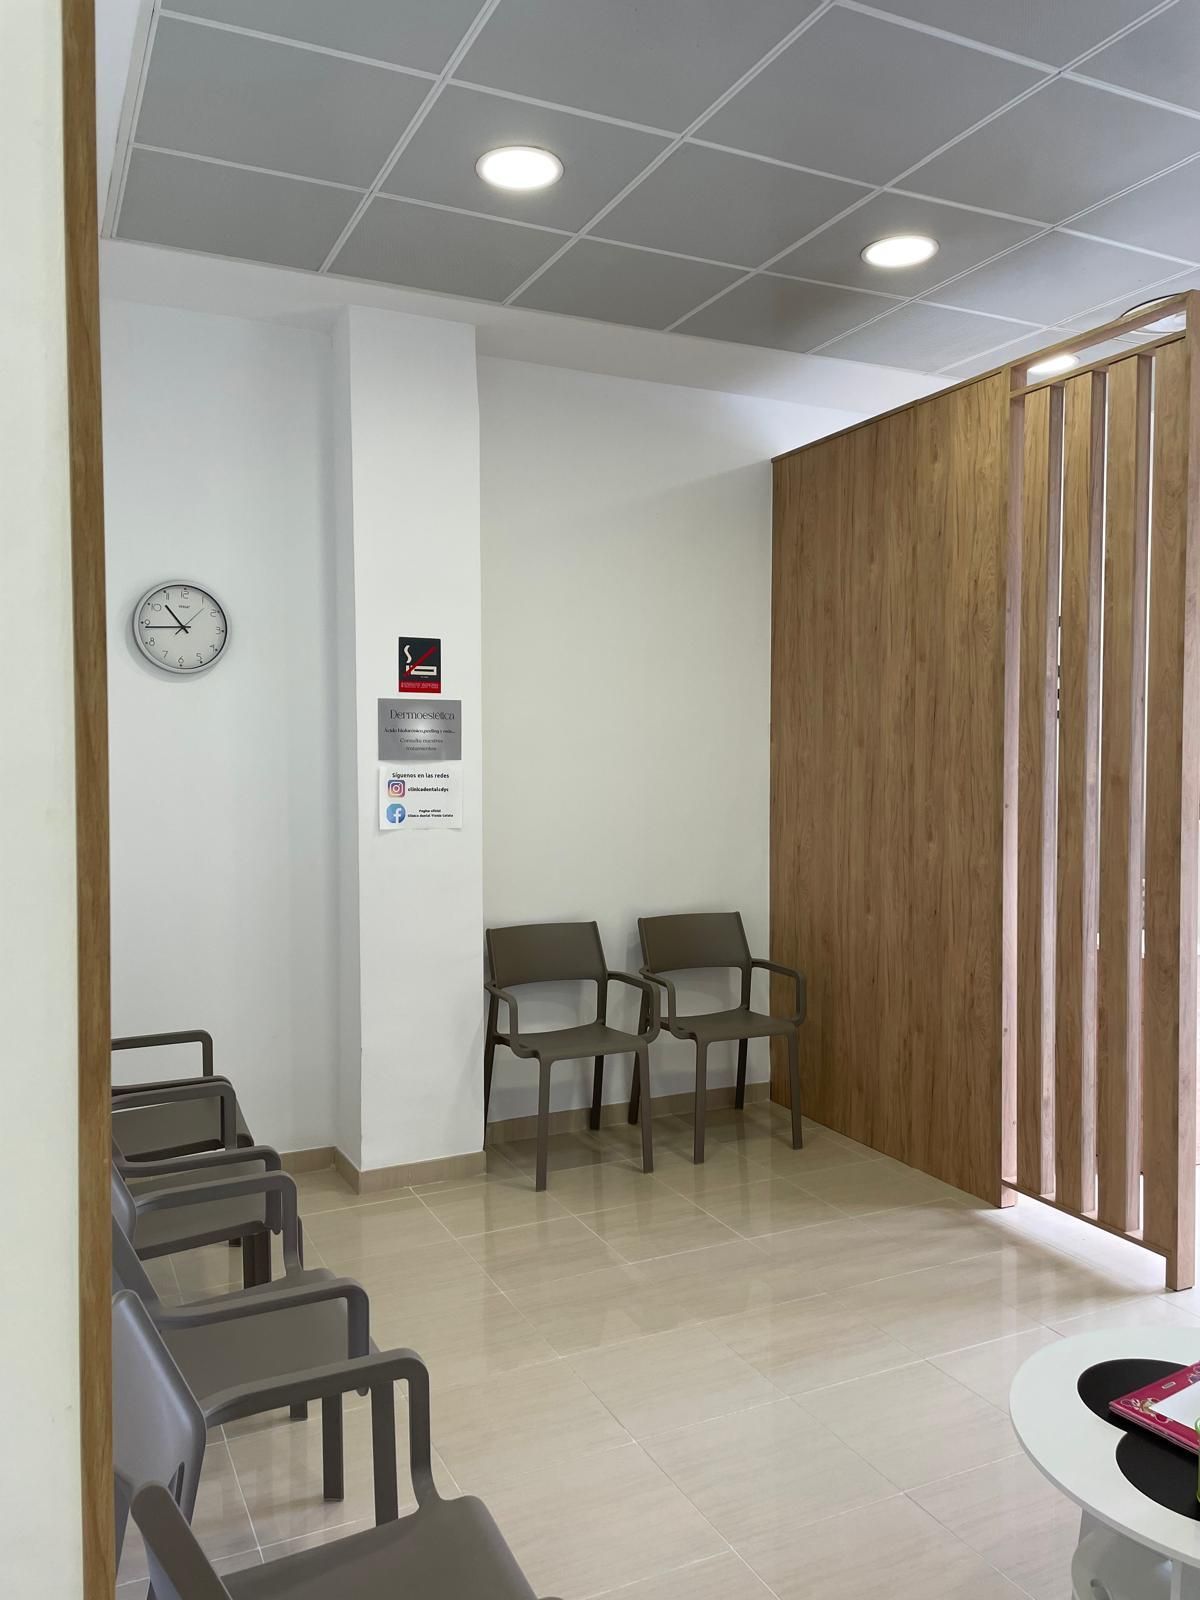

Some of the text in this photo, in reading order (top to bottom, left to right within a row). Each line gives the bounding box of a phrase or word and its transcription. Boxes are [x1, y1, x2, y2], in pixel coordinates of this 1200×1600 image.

[180, 590, 189, 600] 12
[151, 603, 162, 612] 10
[209, 608, 217, 618] 2
[215, 626, 221, 635] 3
[148, 637, 156, 647] 8
[209, 644, 215, 653] 4
[162, 650, 169, 659] 7
[195, 653, 203, 662] 5
[177, 655, 185, 665] 6
